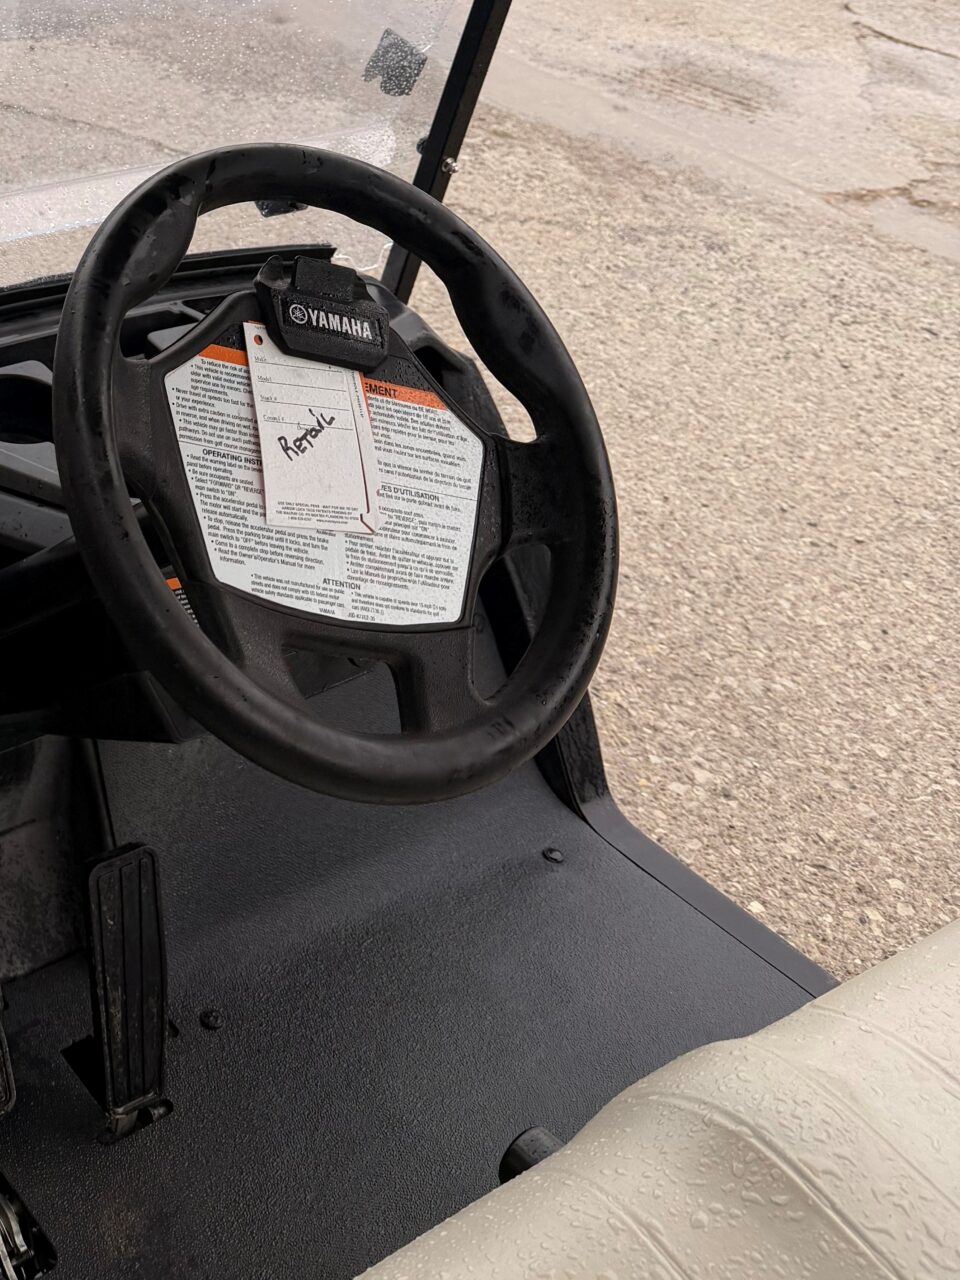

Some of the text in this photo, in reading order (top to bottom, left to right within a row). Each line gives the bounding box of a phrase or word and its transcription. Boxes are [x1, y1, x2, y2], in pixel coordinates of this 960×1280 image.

[308, 308, 372, 340] YAMAHA
[202, 448, 242, 463] OPERATING
[393, 487, 439, 502] D'UTILISATION
[323, 578, 360, 590] ATTENTION
